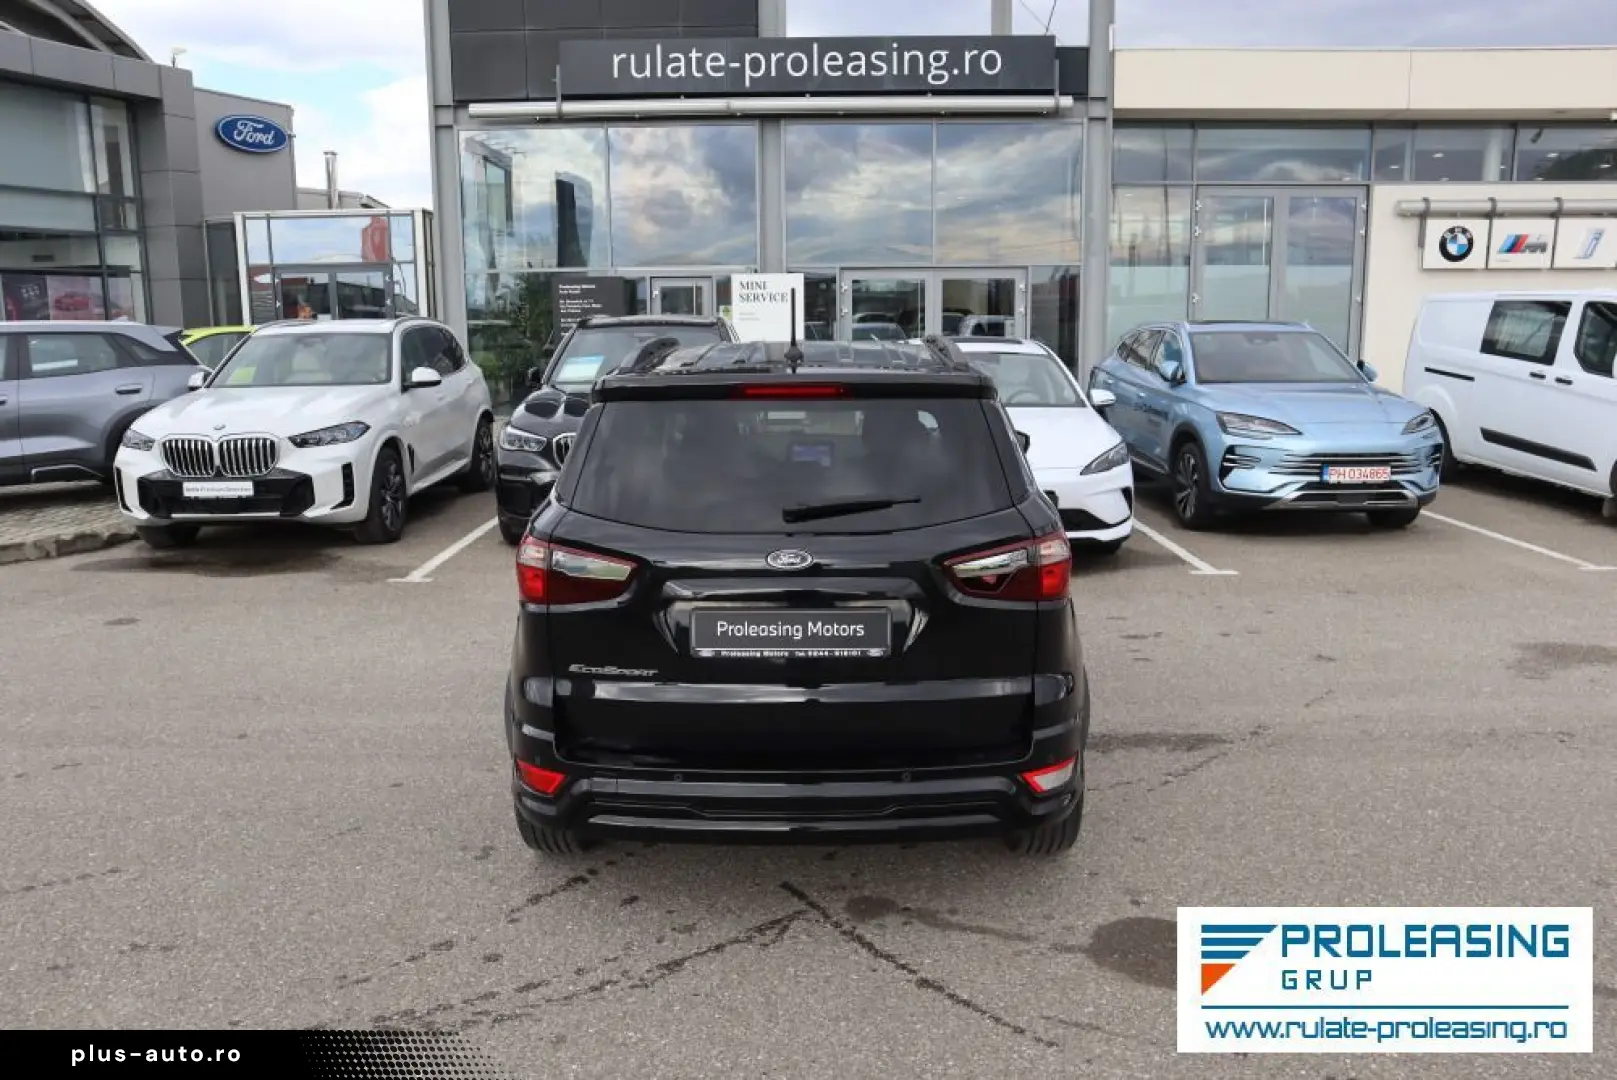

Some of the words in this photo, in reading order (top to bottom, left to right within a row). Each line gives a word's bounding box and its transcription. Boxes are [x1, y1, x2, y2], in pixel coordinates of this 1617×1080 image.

[612, 42, 1003, 87] rulate-proleasing.ro
[233, 120, 275, 145] Ford
[740, 280, 767, 290] MINI
[739, 292, 788, 302] SERVICE
[1329, 468, 1345, 479] PH
[717, 621, 803, 640] Proleasing
[808, 621, 865, 637] Motors
